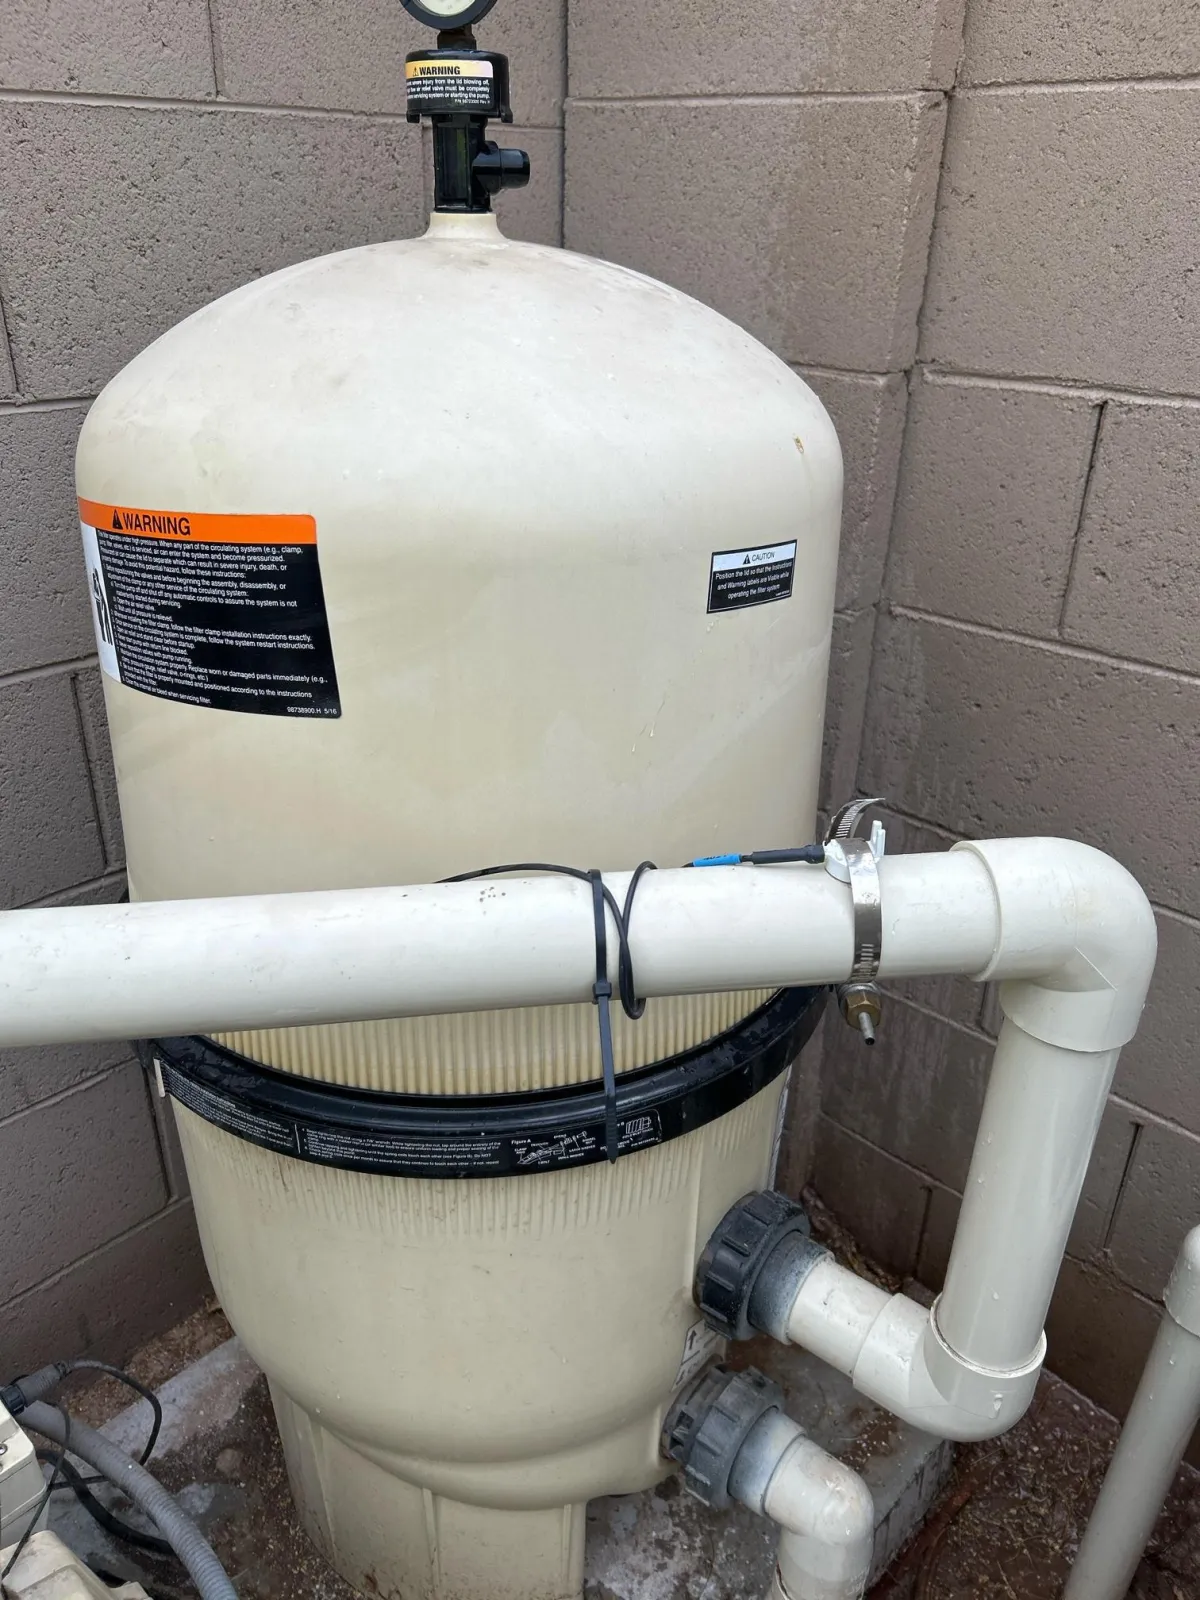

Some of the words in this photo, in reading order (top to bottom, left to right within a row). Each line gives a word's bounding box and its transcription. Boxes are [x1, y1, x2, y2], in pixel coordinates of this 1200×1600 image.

[419, 66, 460, 75] WARNING
[123, 513, 191, 536] WARNING
[174, 542, 182, 550] any
[211, 545, 239, 553] circulating
[752, 552, 775, 561] CAUTION
[716, 571, 734, 580] Position
[176, 576, 201, 586] beginning
[256, 599, 278, 607] system
[209, 636, 224, 644] follow
[222, 630, 251, 638] installation
[253, 631, 287, 640] instructions
[229, 670, 255, 680] damaged
[273, 674, 310, 682] immediately
[231, 687, 258, 696] according
[266, 688, 275, 696] the
[277, 690, 312, 698] instructions
